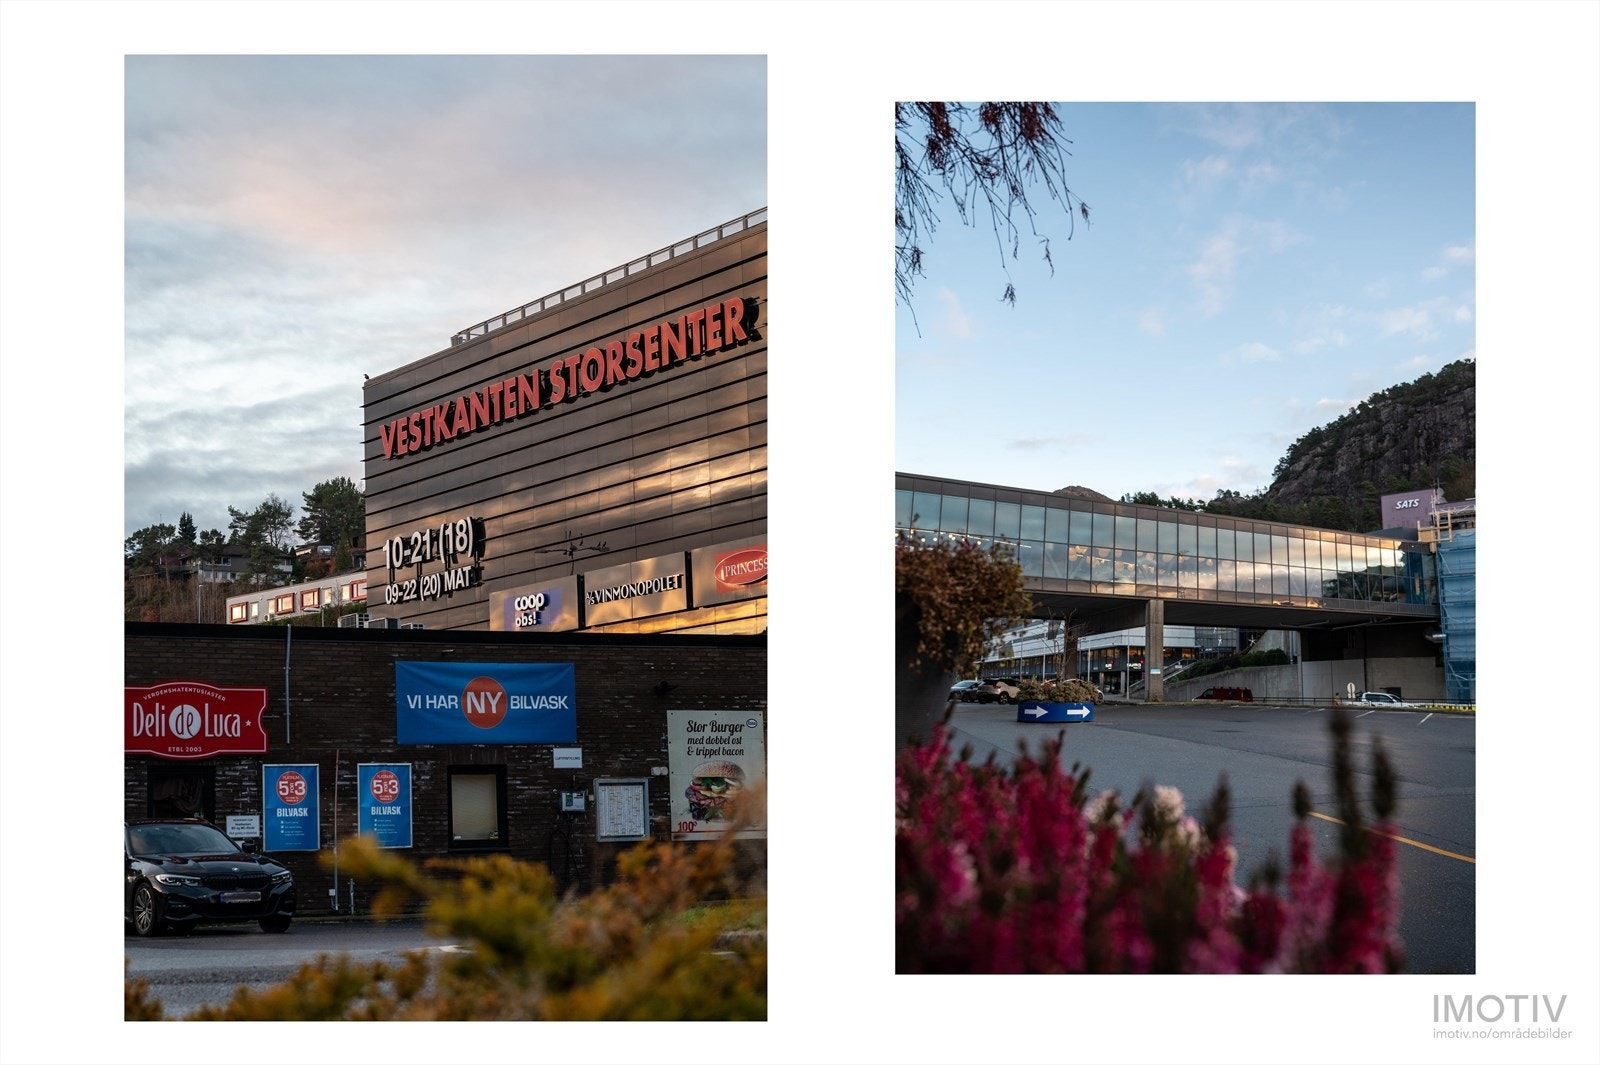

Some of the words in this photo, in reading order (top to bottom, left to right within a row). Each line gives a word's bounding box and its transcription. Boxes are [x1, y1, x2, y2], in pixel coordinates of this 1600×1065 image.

[379, 369, 540, 459] VESTKANTEN
[549, 297, 747, 404] STORSENTER
[1395, 498, 1420, 510] SATS
[382, 528, 434, 569] 10-21
[438, 516, 474, 564] (18)
[385, 582, 417, 605] 09-22
[419, 575, 441, 599] (20)
[444, 566, 472, 591] MAT
[595, 574, 680, 604] VINMONOPOLET
[514, 592, 546, 611] coop
[515, 611, 537, 627] obs!
[143, 687, 226, 702] VERDENSMATENTUSIASTER
[407, 694, 422, 709] VI
[425, 694, 458, 709] HAR
[466, 691, 503, 714] NY
[510, 695, 569, 710] BILVASK
[132, 702, 166, 737] Deli
[175, 704, 195, 737] de
[204, 703, 241, 738] Luca
[686, 720, 708, 733] Stor
[709, 720, 745, 736] Burger
[687, 736, 705, 745] med
[705, 735, 731, 745] dobbel
[731, 736, 742, 745] ost
[687, 746, 695, 756] &
[695, 746, 721, 758] trippel
[722, 746, 744, 756] bacon
[279, 780, 289, 796] 5
[294, 780, 306, 796] 3
[373, 779, 383, 795] 5
[388, 779, 399, 795] 3
[276, 807, 309, 818] BILVASK
[370, 806, 402, 816] BILVASK
